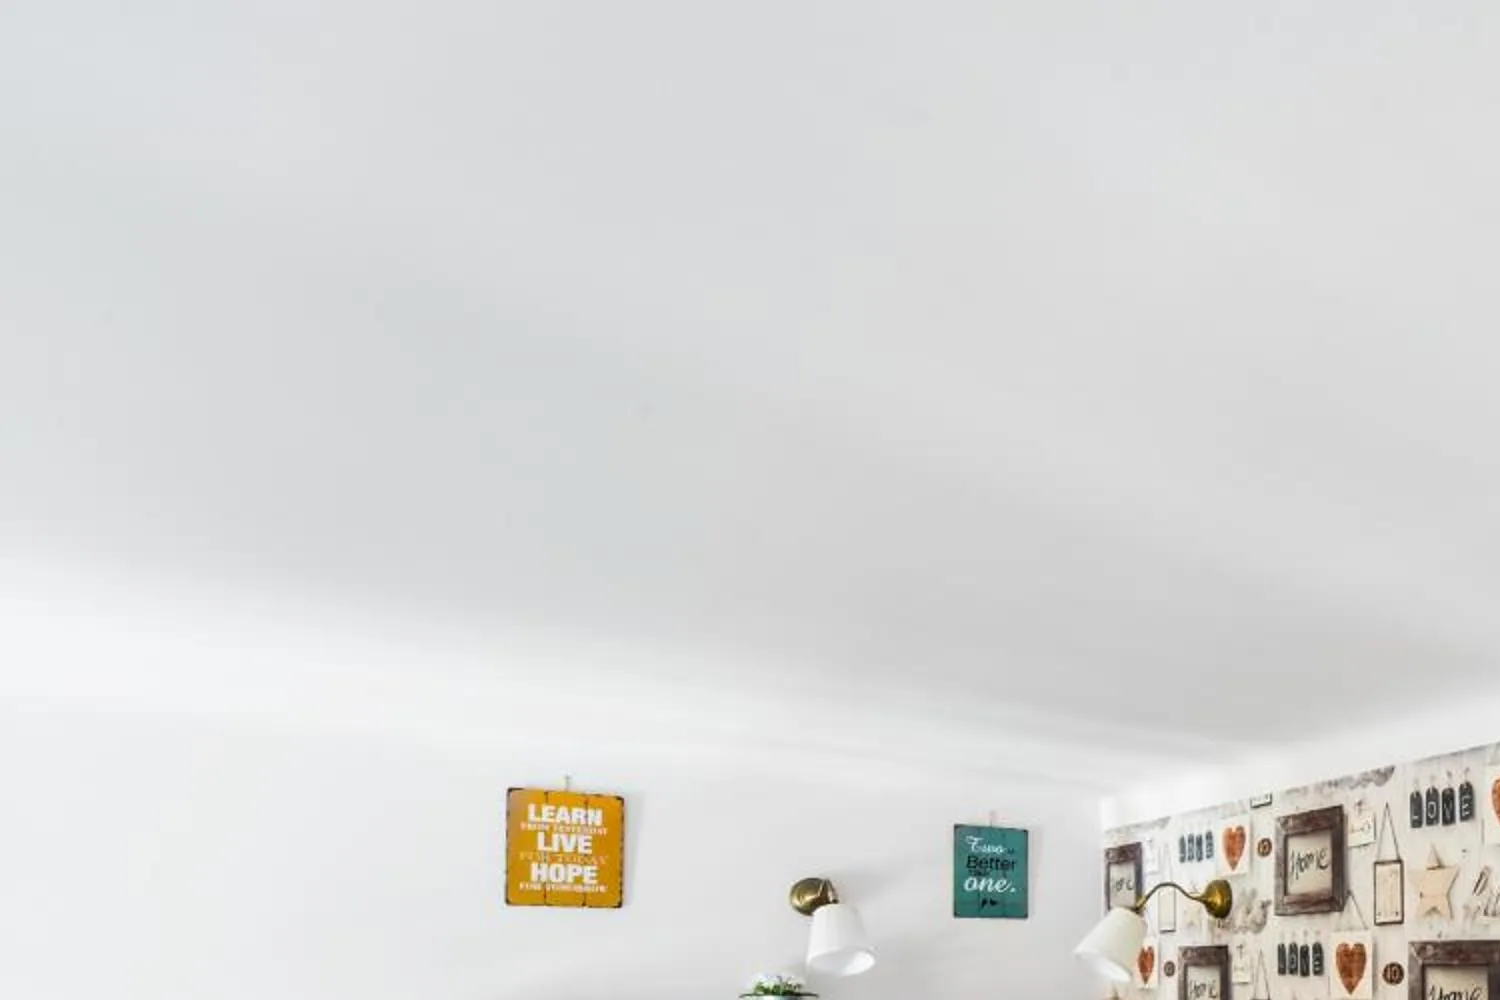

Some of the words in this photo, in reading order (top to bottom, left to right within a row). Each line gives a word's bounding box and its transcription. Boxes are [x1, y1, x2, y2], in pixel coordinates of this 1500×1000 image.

[527, 803, 604, 826] LEARN
[1411, 795, 1471, 822] LOVE
[536, 832, 593, 855] LIVE
[530, 862, 599, 884] HOPE
[1289, 847, 1330, 884] Home
